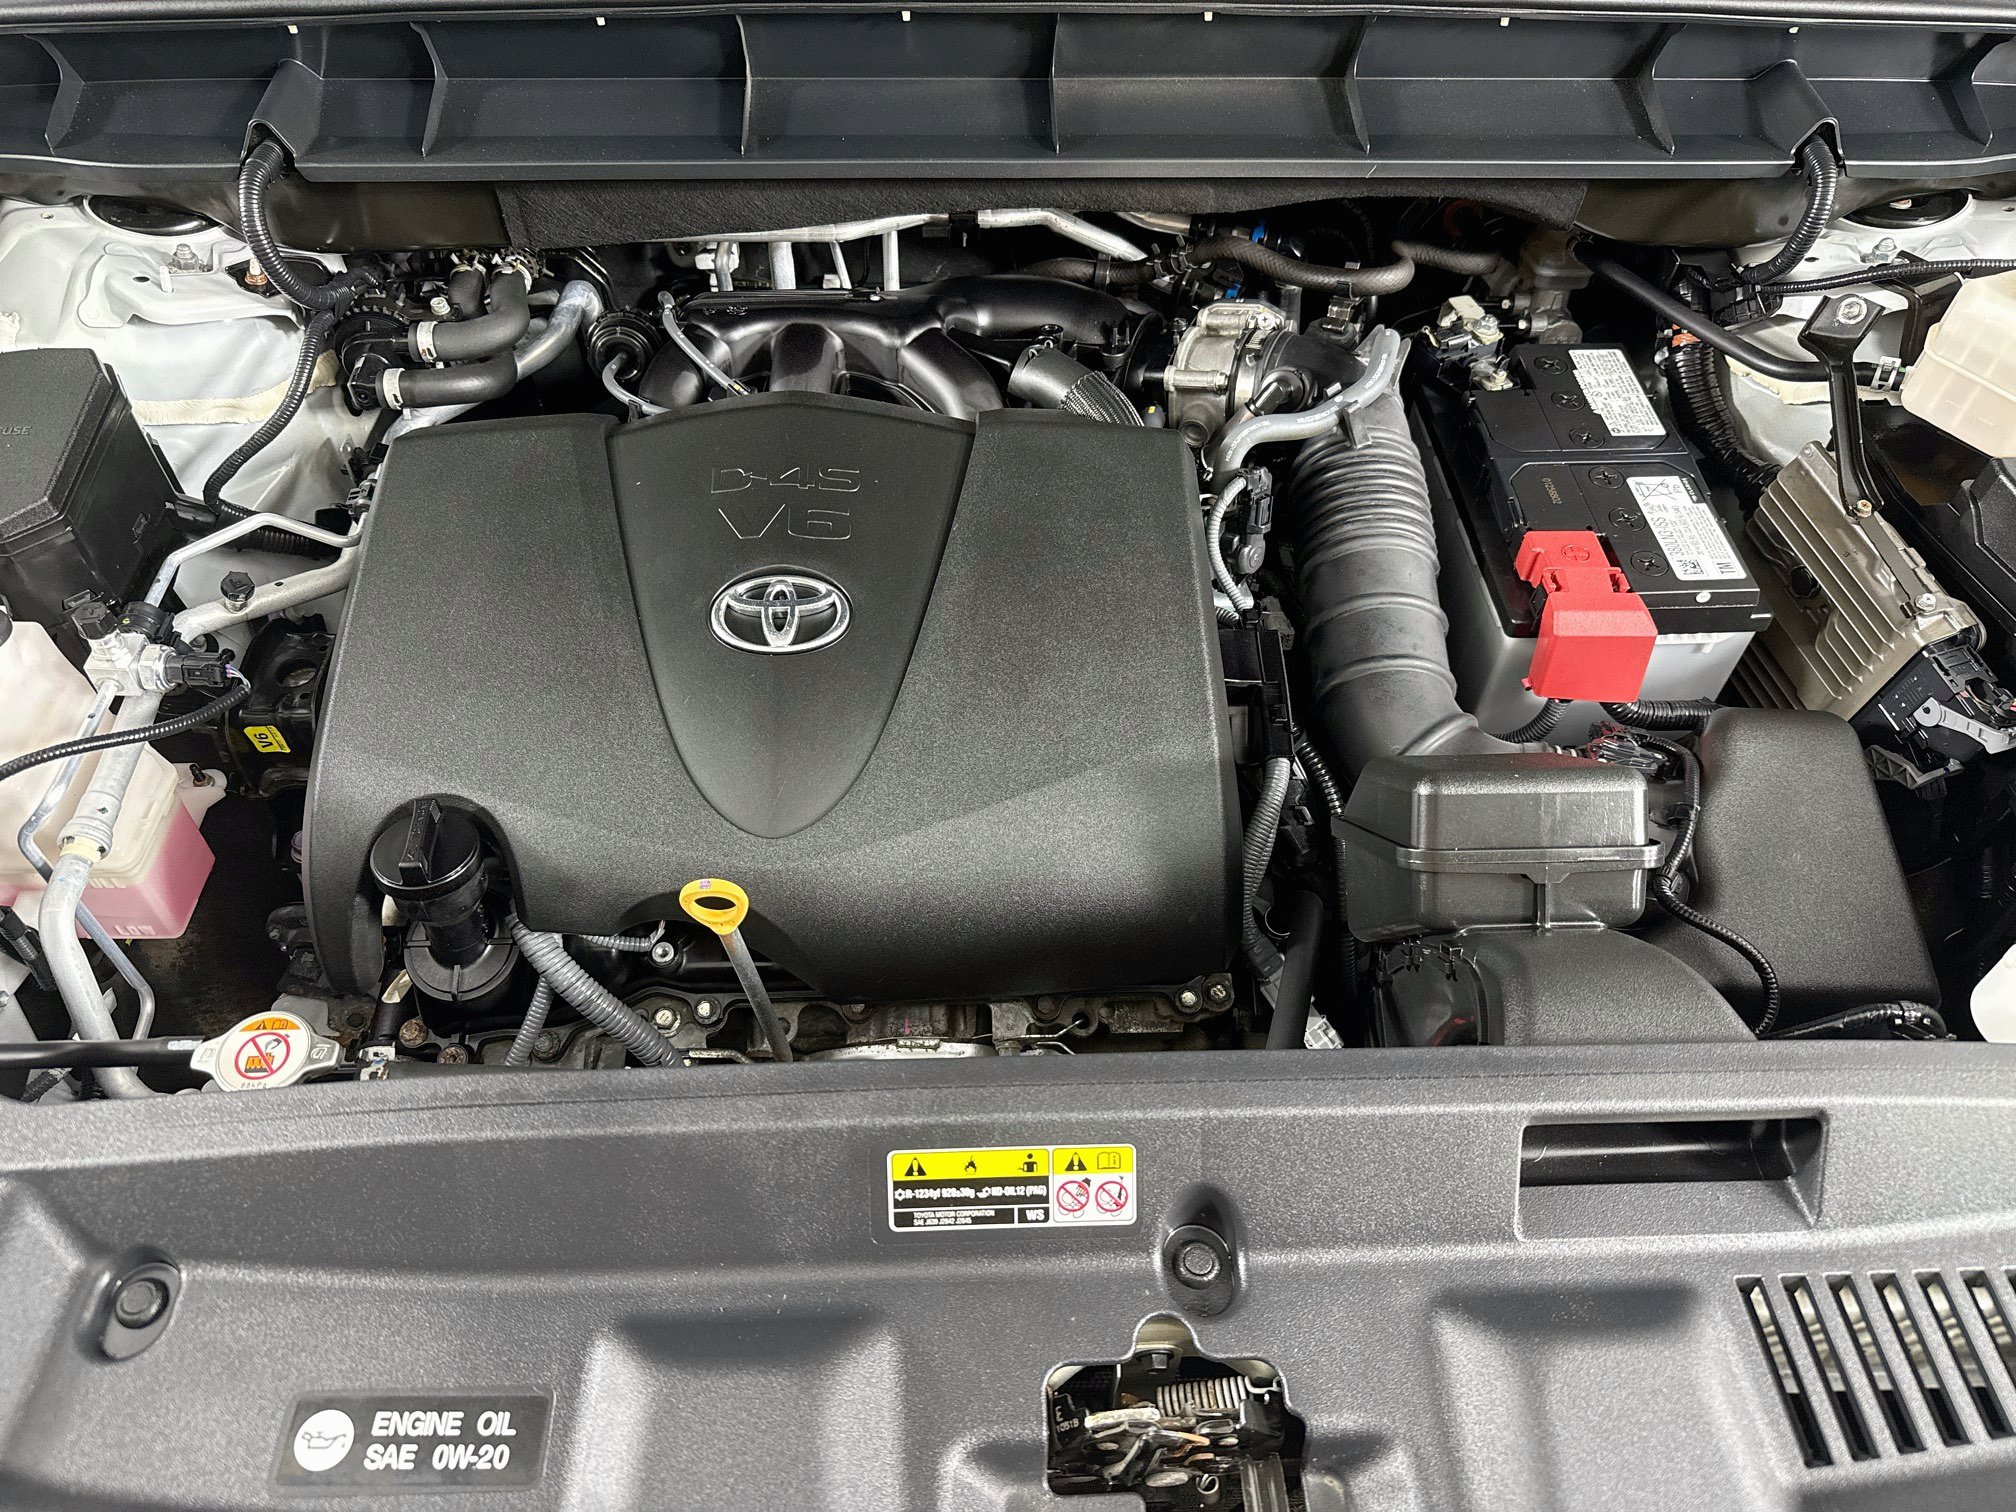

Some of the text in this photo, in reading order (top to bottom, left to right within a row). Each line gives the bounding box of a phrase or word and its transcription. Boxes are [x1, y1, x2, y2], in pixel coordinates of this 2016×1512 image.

[711, 463, 861, 493] D-4S
[718, 503, 852, 540] V6
[254, 732, 274, 748] V6
[114, 925, 156, 936] LOW
[913, 1209, 995, 1219] TOYOTA MOTOR CORPORATION
[1025, 1208, 1045, 1221] WS
[371, 1410, 517, 1437] ENGINE OIL
[363, 1443, 511, 1471] SAE 0W-20
